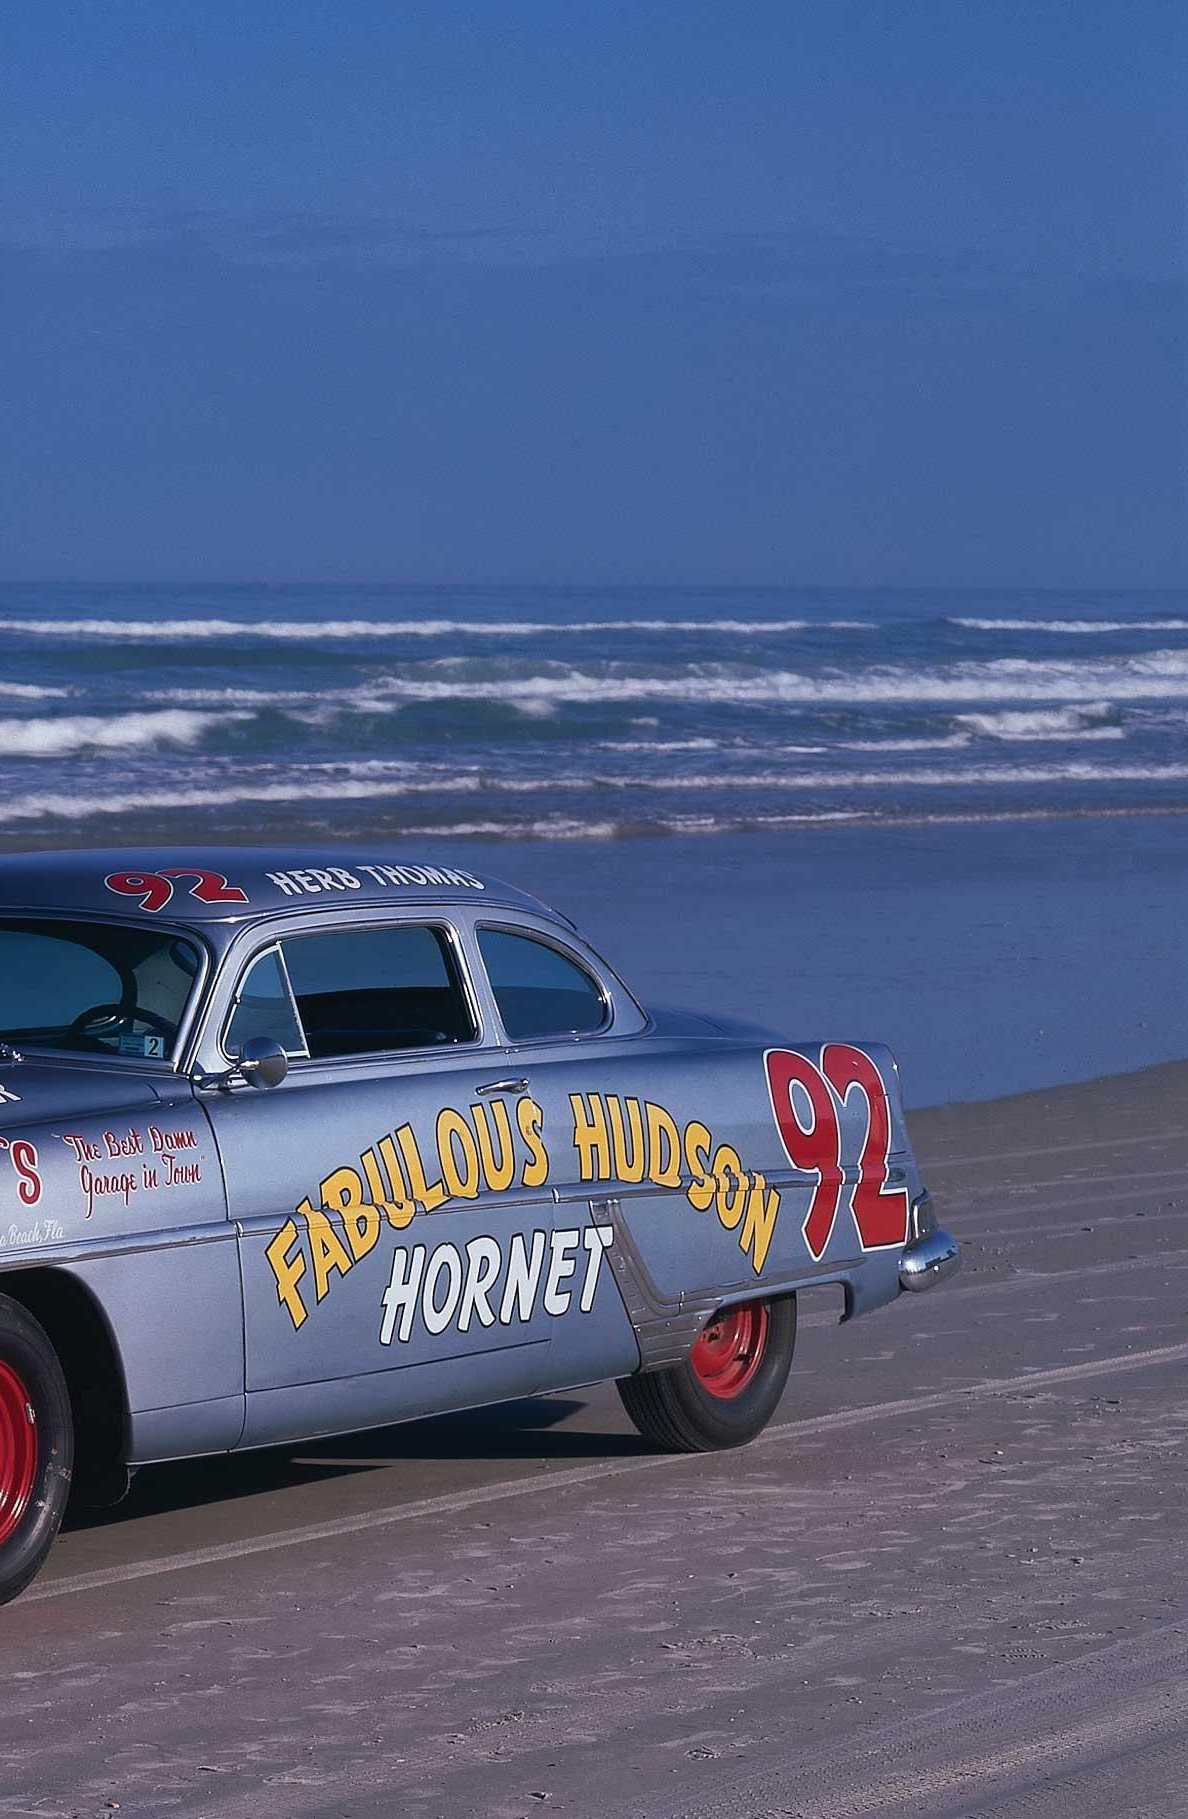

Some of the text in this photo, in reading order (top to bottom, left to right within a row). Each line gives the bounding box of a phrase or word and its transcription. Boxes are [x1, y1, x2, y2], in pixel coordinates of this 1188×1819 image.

[104, 868, 250, 913] 92
[265, 864, 486, 897] HERB THOMAS
[148, 1037, 159, 1056] 2
[102, 1127, 144, 1159] Best
[147, 1125, 198, 1154] Damn
[762, 1042, 910, 1262] 92
[79, 1163, 138, 1221] Garage
[142, 1163, 160, 1190] in
[263, 1091, 781, 1332] FABULOUS HUDSON
[378, 1225, 613, 1347] HORNET
